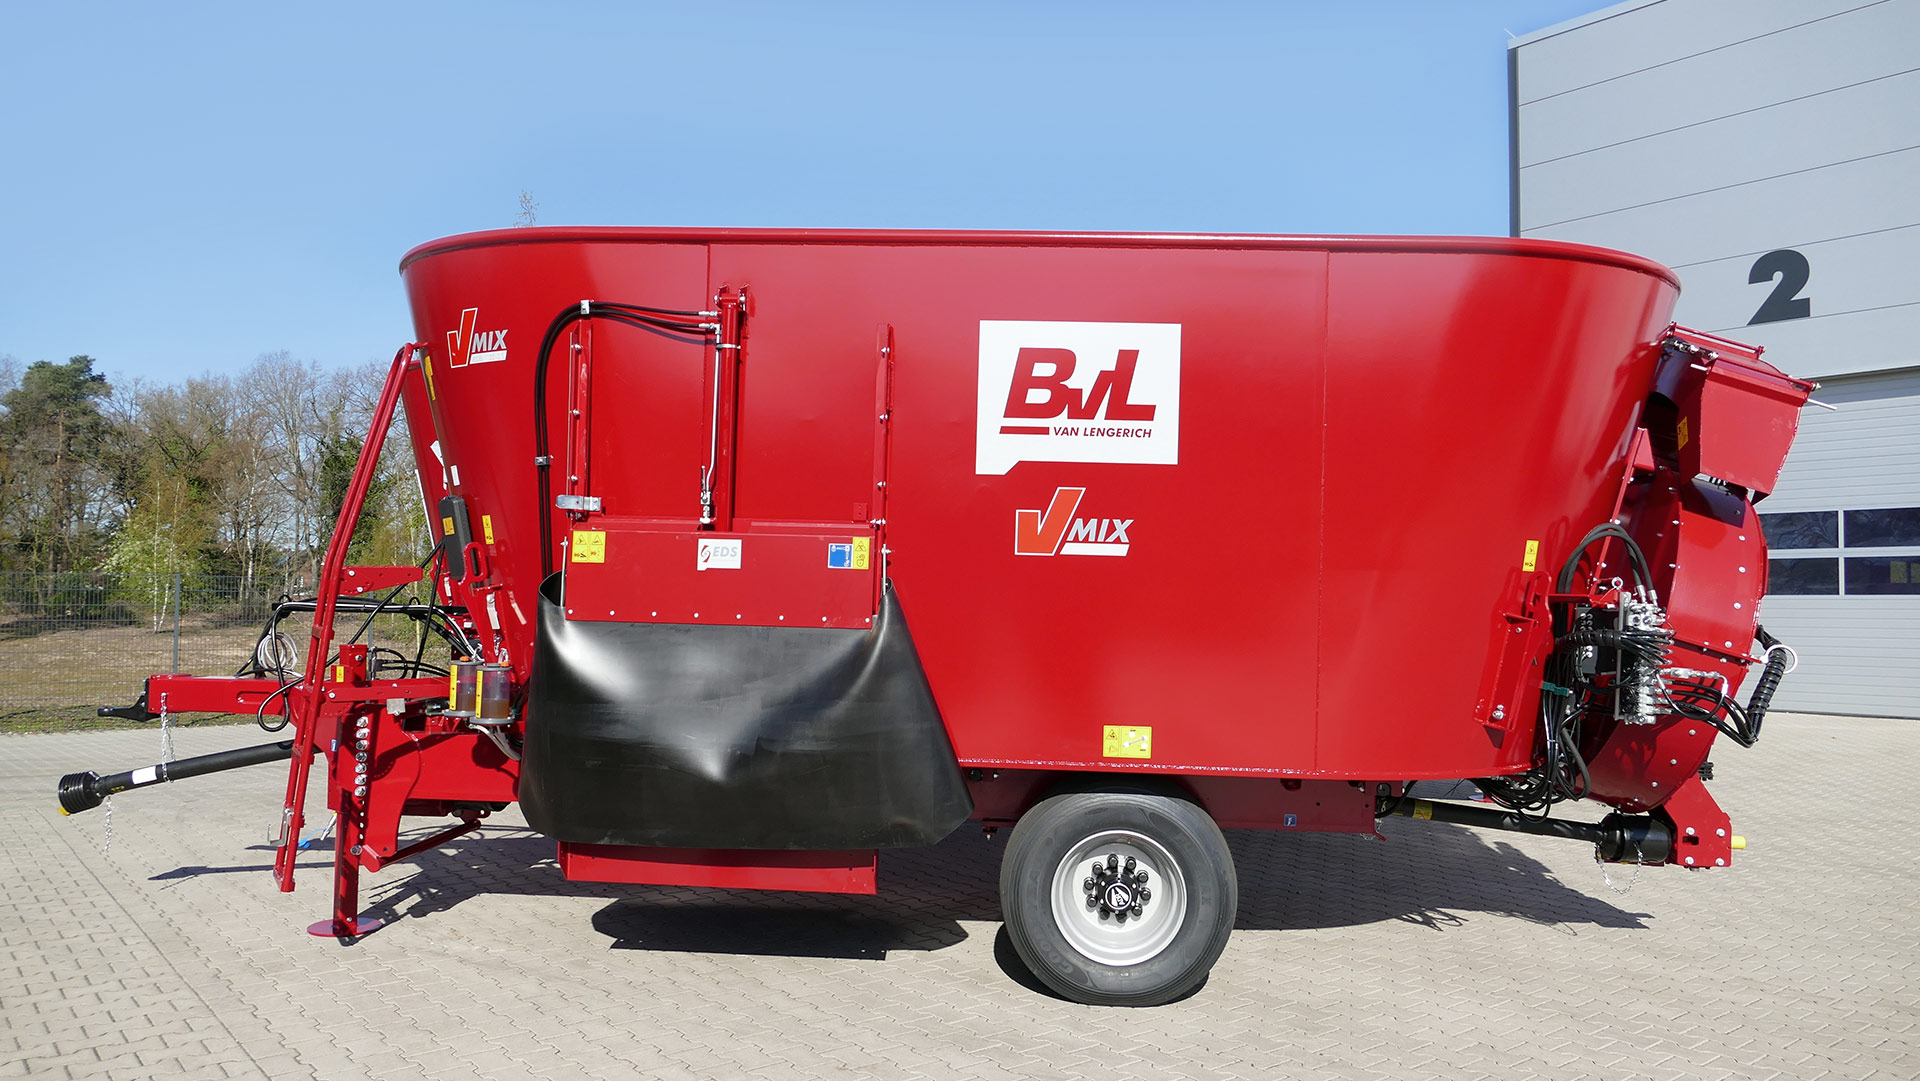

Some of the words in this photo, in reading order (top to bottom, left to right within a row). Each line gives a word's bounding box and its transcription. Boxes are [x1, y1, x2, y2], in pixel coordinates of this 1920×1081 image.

[1746, 249, 1811, 326] 2
[1053, 426, 1080, 437] VAN
[1083, 427, 1152, 438] LENGERICH
[712, 546, 738, 558] EDS
